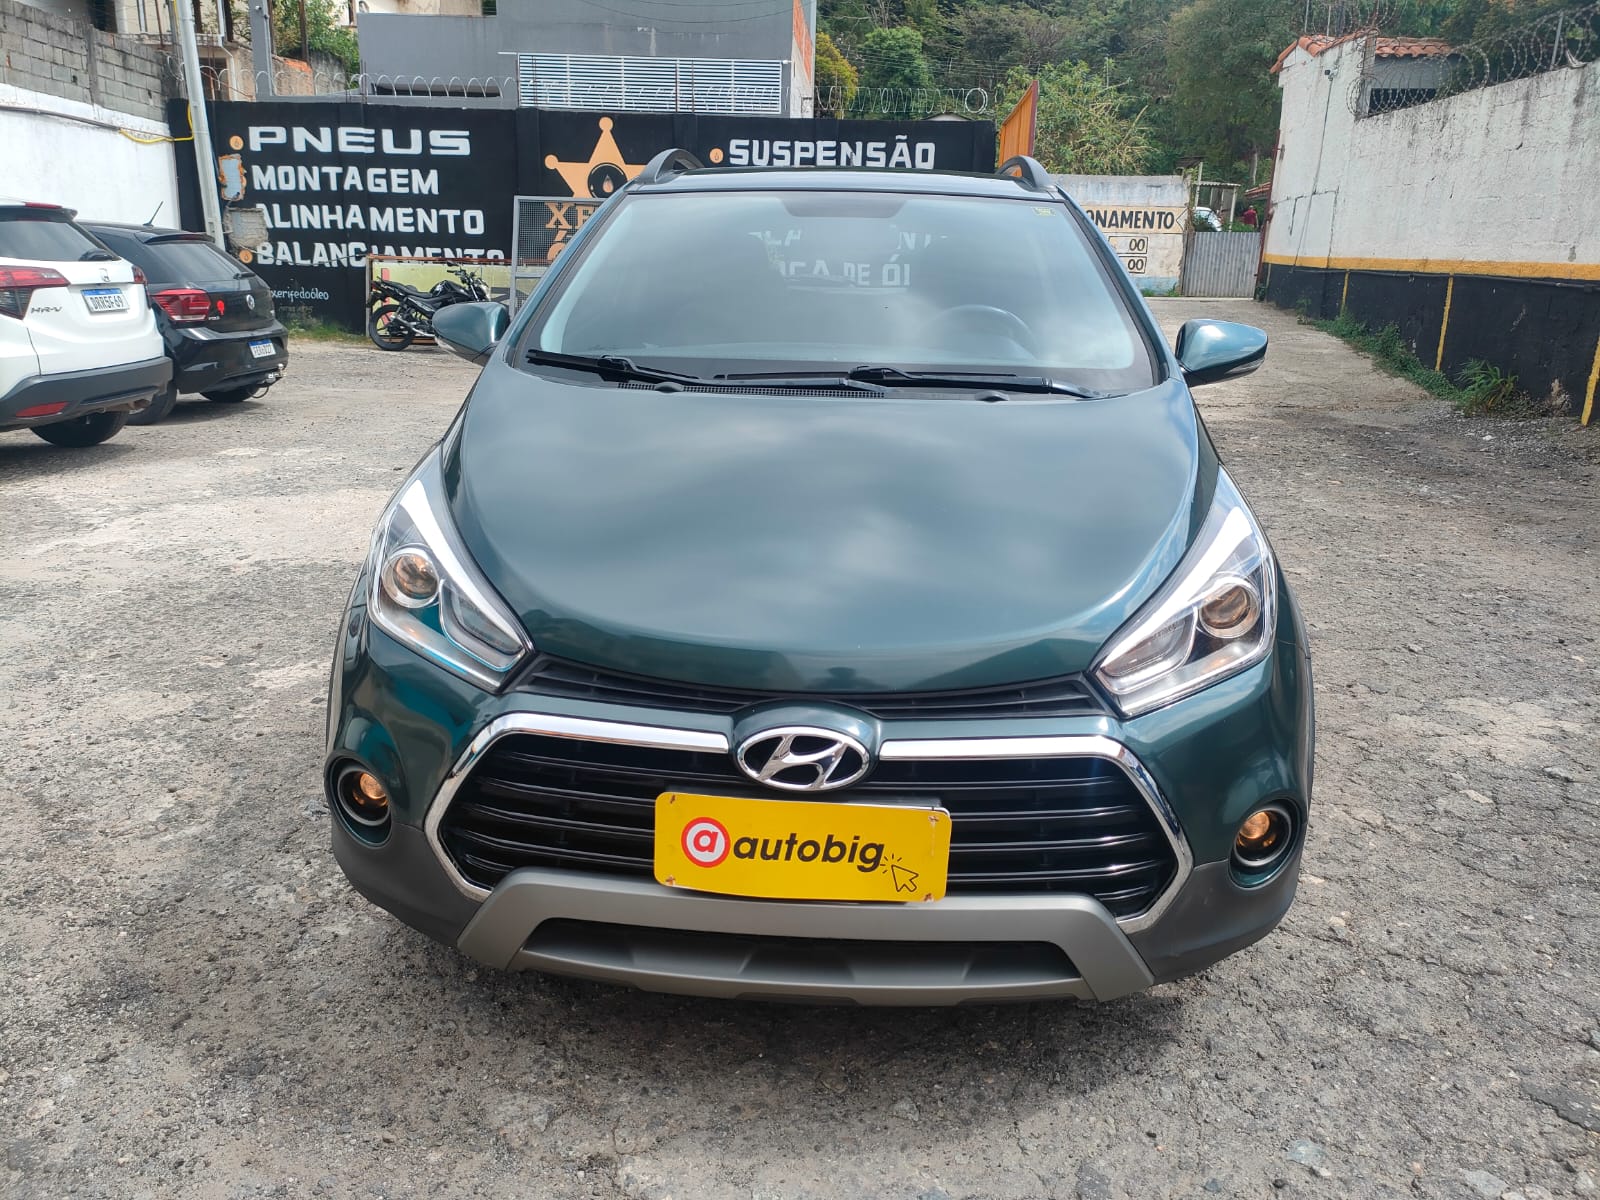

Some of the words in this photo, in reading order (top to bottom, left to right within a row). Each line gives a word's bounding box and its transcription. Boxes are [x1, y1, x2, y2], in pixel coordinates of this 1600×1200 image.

[248, 126, 471, 156] PNEUS
[729, 134, 936, 170] SUSPENSÃO
[251, 165, 439, 195] MONTAGEM
[1128, 238, 1146, 252] 00
[1127, 258, 1144, 271] 00
[733, 832, 885, 873] autobig
